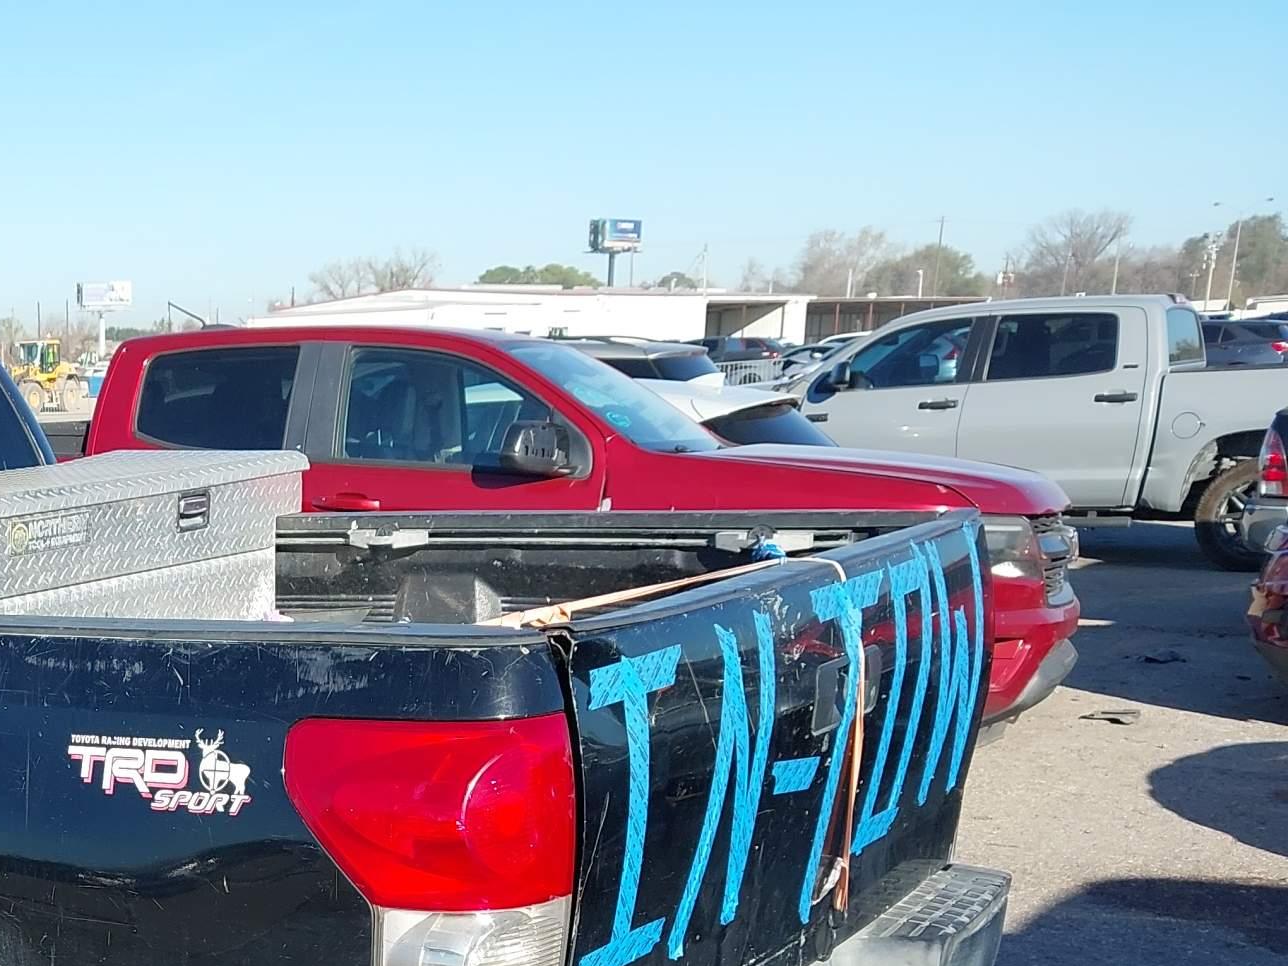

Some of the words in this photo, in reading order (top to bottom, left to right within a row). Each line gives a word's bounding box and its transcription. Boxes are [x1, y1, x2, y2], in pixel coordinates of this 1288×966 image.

[71, 734, 100, 745] TOYOTA
[132, 737, 191, 749] DEVELOPMENT
[67, 745, 190, 799] TRD
[150, 789, 252, 816] SPORT
